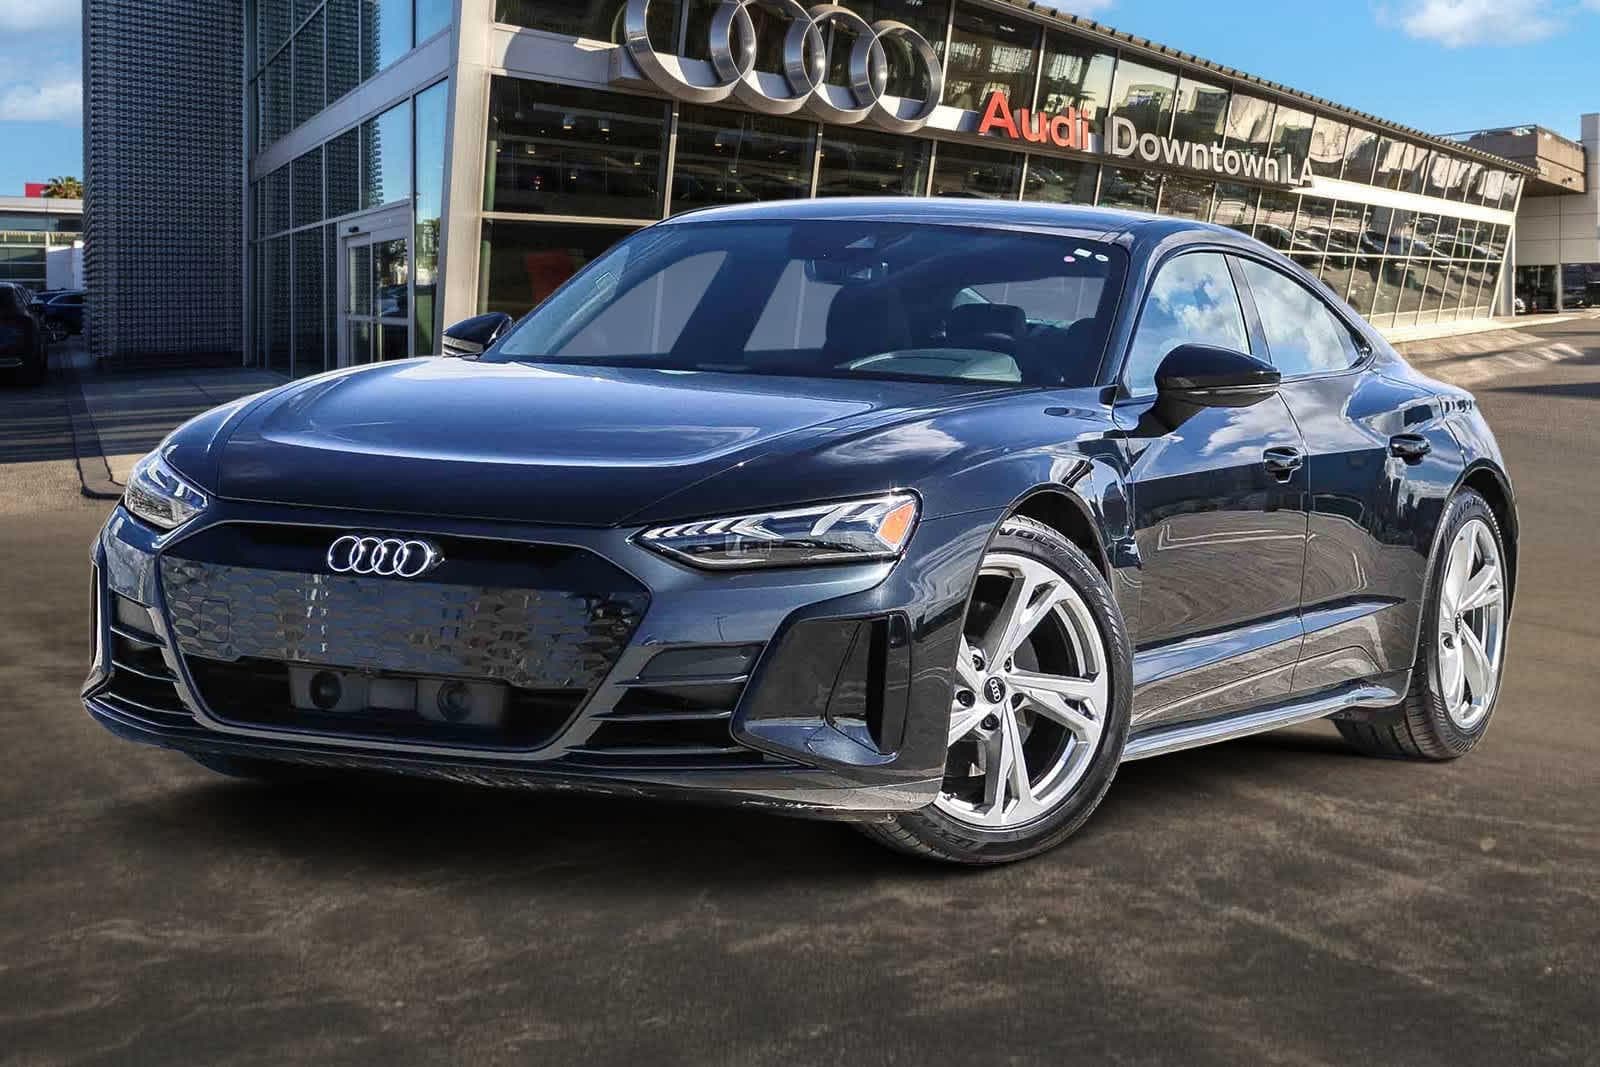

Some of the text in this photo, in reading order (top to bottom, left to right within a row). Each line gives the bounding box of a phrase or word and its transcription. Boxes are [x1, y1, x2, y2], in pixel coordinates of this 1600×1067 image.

[978, 90, 1314, 187] Audi Downtown LA
